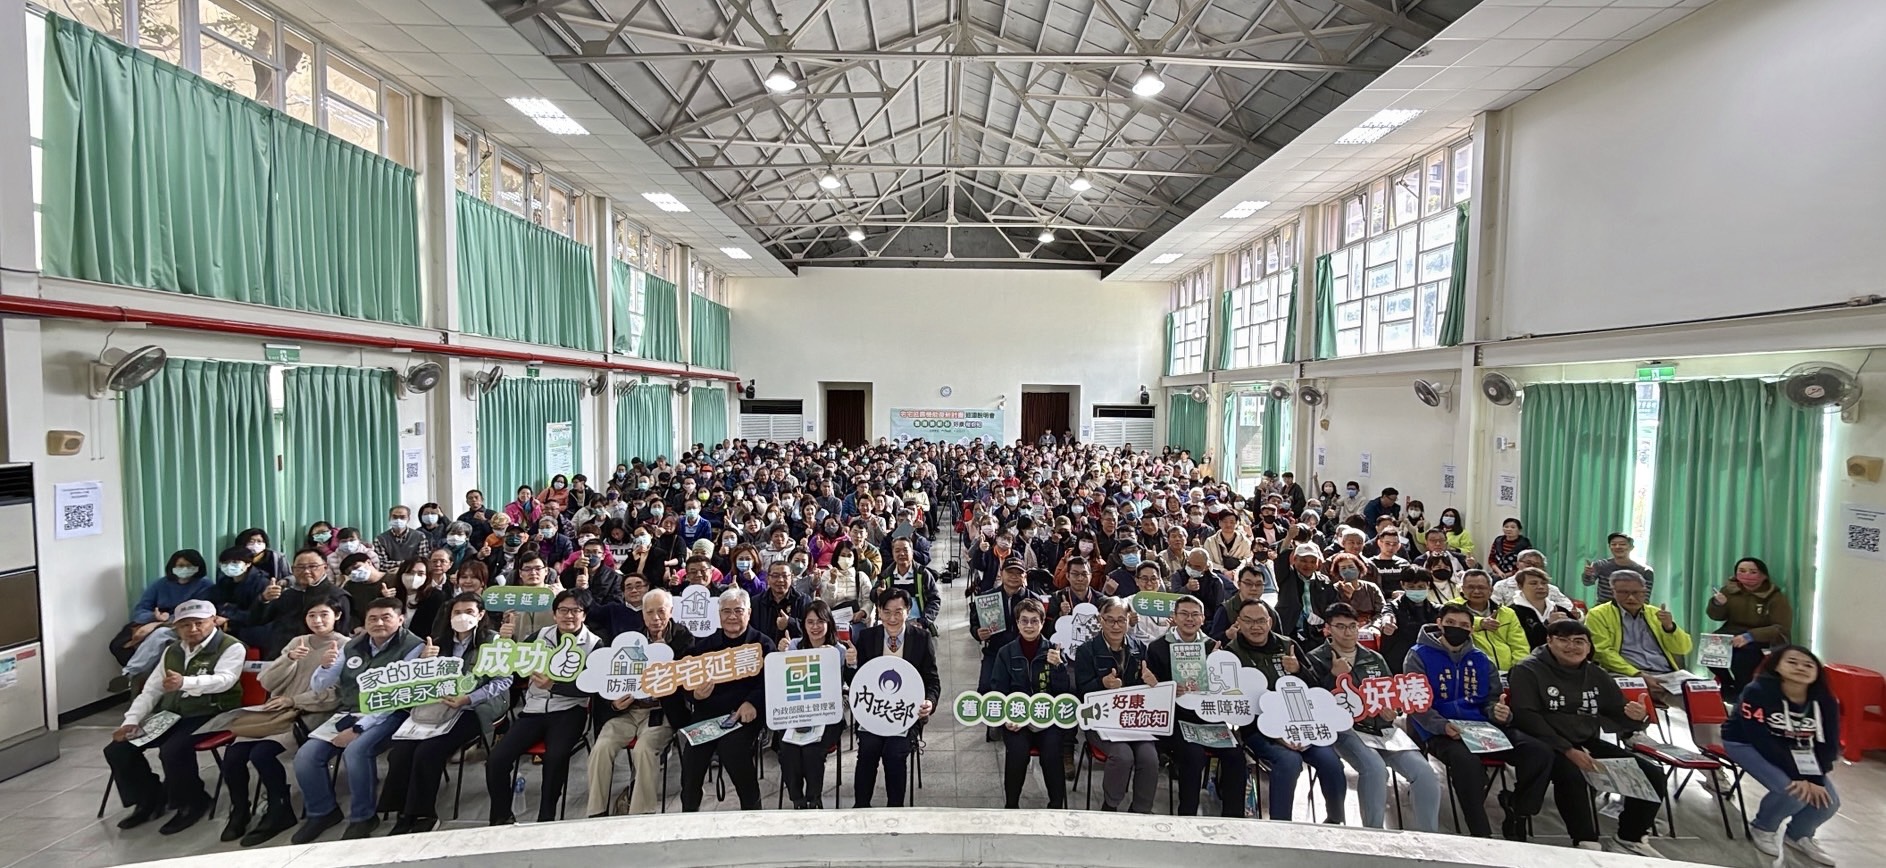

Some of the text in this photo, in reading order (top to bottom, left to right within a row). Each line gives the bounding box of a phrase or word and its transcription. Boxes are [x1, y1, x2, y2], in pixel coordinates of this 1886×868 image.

[486, 592, 551, 606] 老宅延壽
[477, 641, 549, 674] 成功
[360, 659, 460, 690] 家的延續
[644, 647, 760, 693] 老宅延壽
[367, 680, 458, 710] 住得永續
[1112, 694, 1145, 710] 好康
[1364, 674, 1431, 713] 好棒
[854, 685, 915, 726] 內政部
[962, 700, 1075, 719] 舊厝換新衫
[1201, 700, 1251, 716] 無障礙
[1741, 702, 1765, 723] 54
[1121, 711, 1168, 727] 報你知
[1285, 724, 1332, 742] 增電梯
